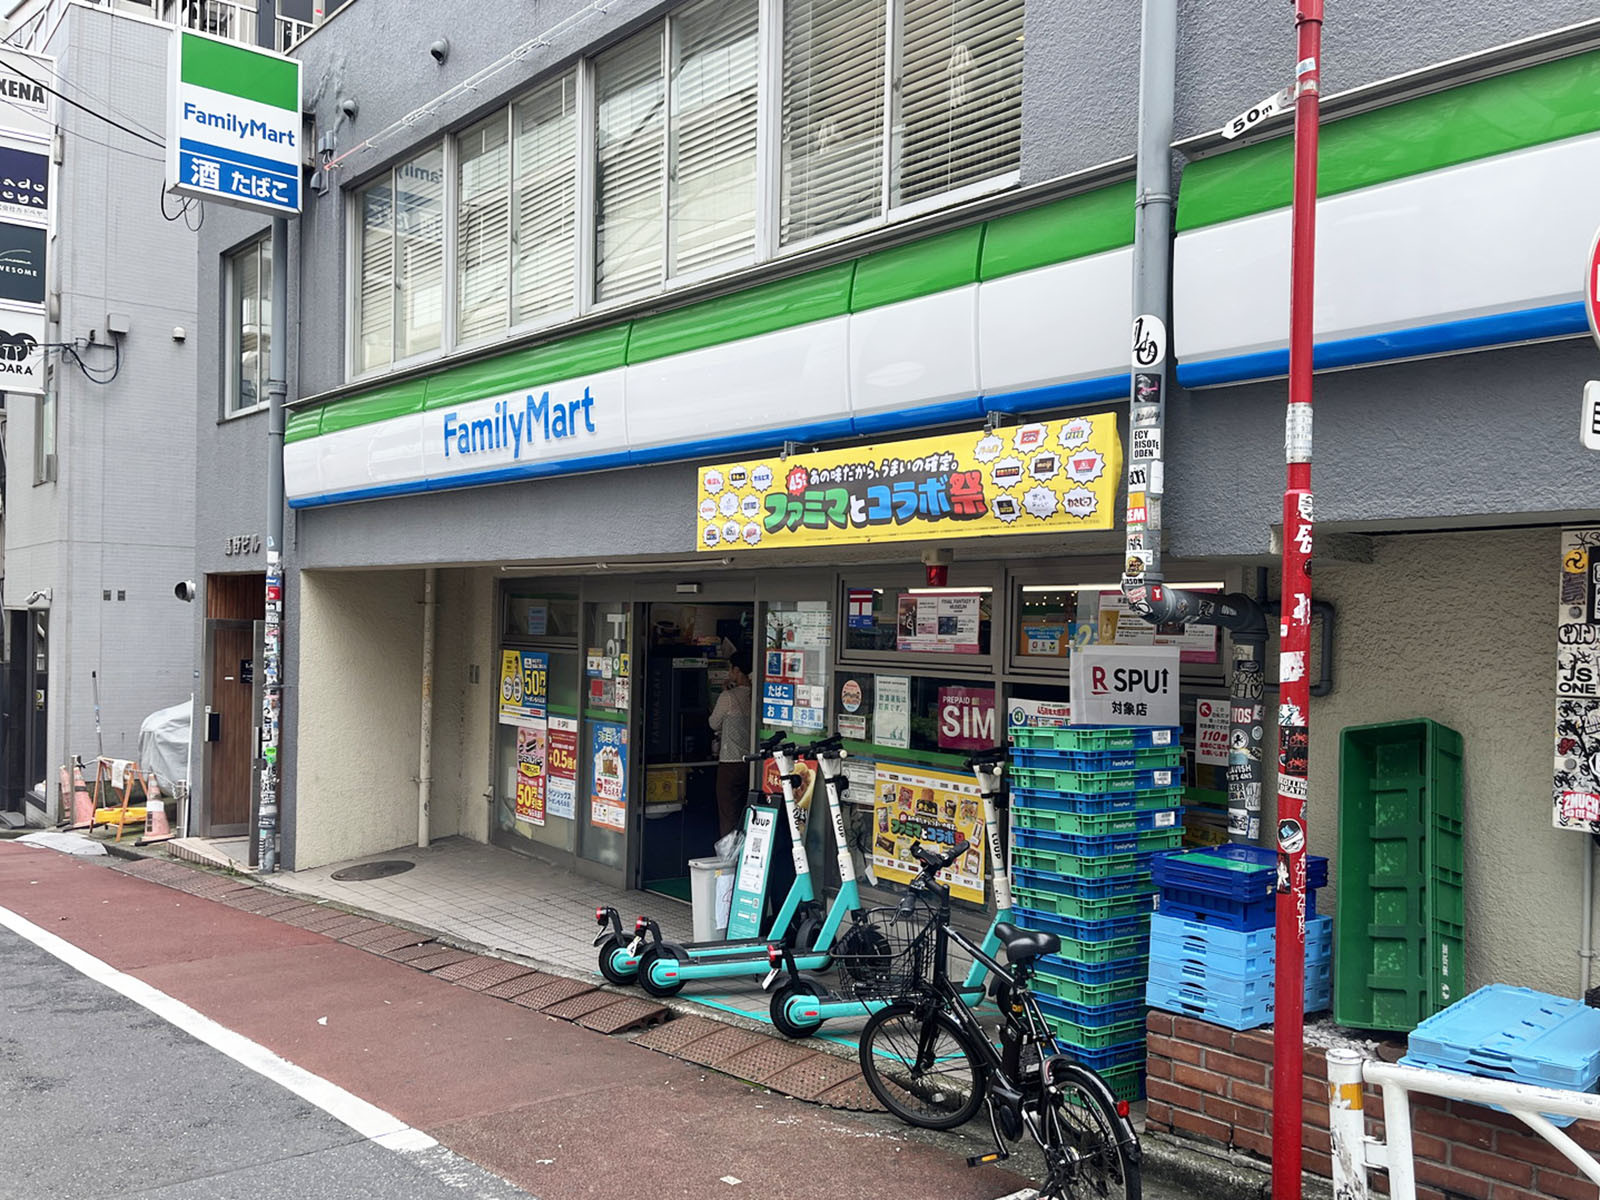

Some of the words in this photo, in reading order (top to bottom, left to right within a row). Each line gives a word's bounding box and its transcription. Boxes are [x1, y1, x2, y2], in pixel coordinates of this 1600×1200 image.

[183, 102, 296, 147] FamilyMart
[190, 157, 221, 191] 酒
[231, 171, 289, 203] たばこ
[444, 386, 596, 459] FamilyMart
[763, 470, 989, 533] ファミマとコラボ祭
[1563, 664, 1592, 682] JS
[768, 684, 789, 698] たばこ
[942, 695, 970, 705] PREPAID
[1558, 682, 1596, 695] ONE
[1112, 701, 1148, 716] 対象店
[942, 706, 995, 740] SIM
[834, 813, 845, 838] LUUP
[991, 832, 1002, 860] LUUP
